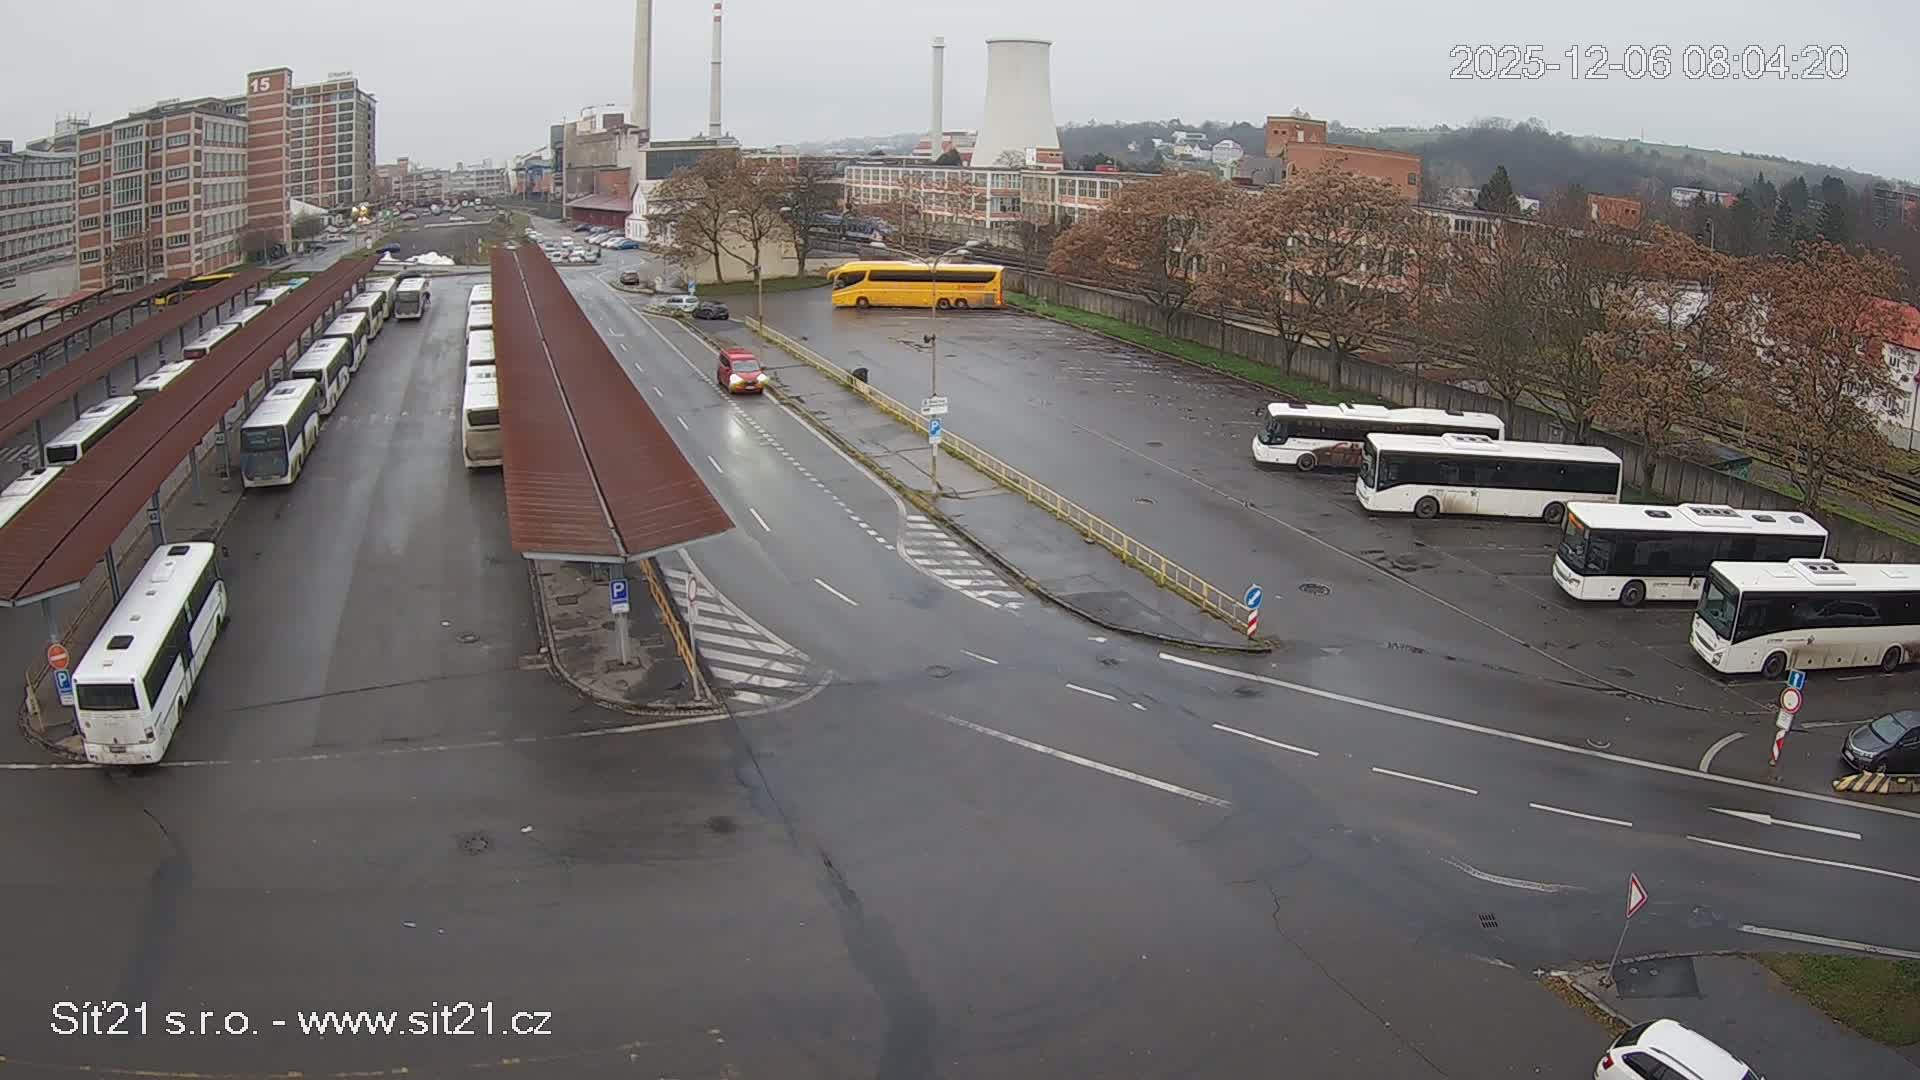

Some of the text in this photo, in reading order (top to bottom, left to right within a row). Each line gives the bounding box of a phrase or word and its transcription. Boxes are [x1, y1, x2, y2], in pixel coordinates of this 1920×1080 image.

[250, 77, 271, 93] 15
[613, 582, 625, 598] P
[58, 672, 67, 687] P
